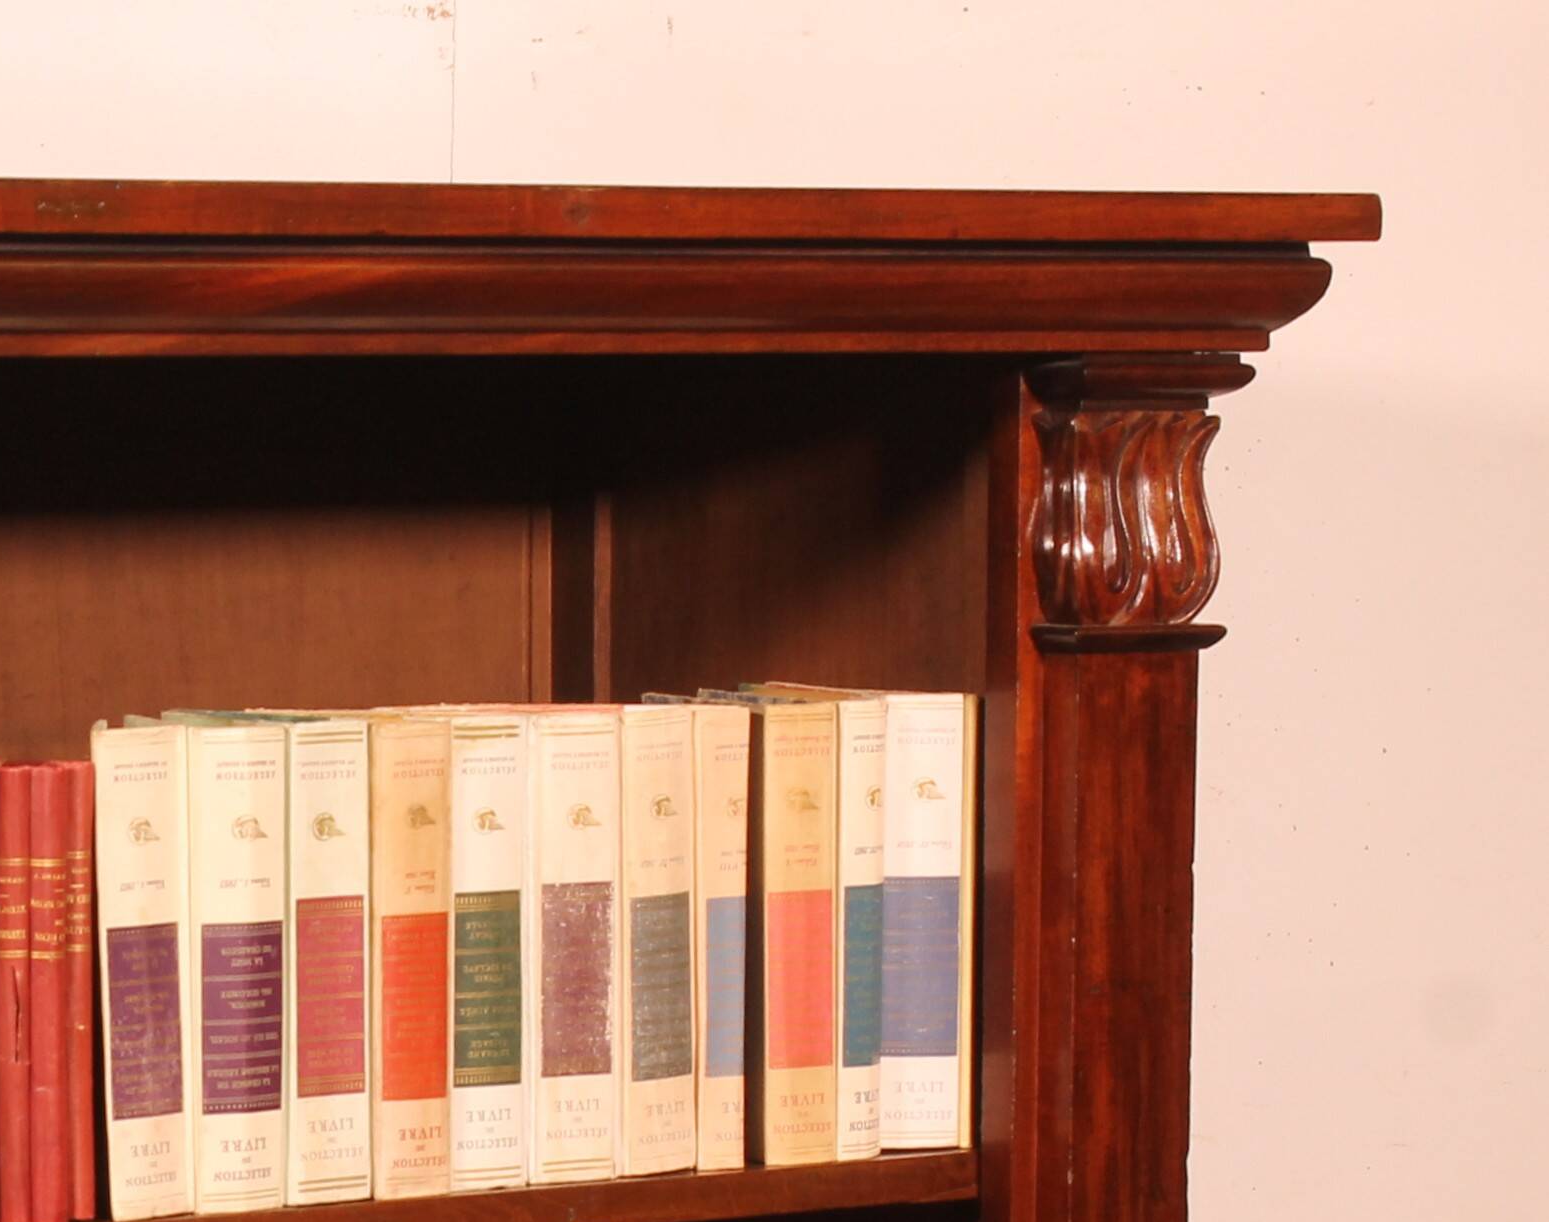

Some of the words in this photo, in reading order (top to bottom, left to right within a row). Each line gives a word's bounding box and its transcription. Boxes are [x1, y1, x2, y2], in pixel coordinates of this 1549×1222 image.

[894, 1081, 945, 1094] LIVRE
[553, 1098, 600, 1112] LIVRE
[780, 1093, 826, 1106] LIVRE
[466, 1108, 511, 1123] LIVRE
[307, 1117, 354, 1134] LIVRE
[398, 1126, 442, 1141] LIVRE
[131, 1140, 170, 1157] LIVRE
[223, 1136, 267, 1153] LIVRE
